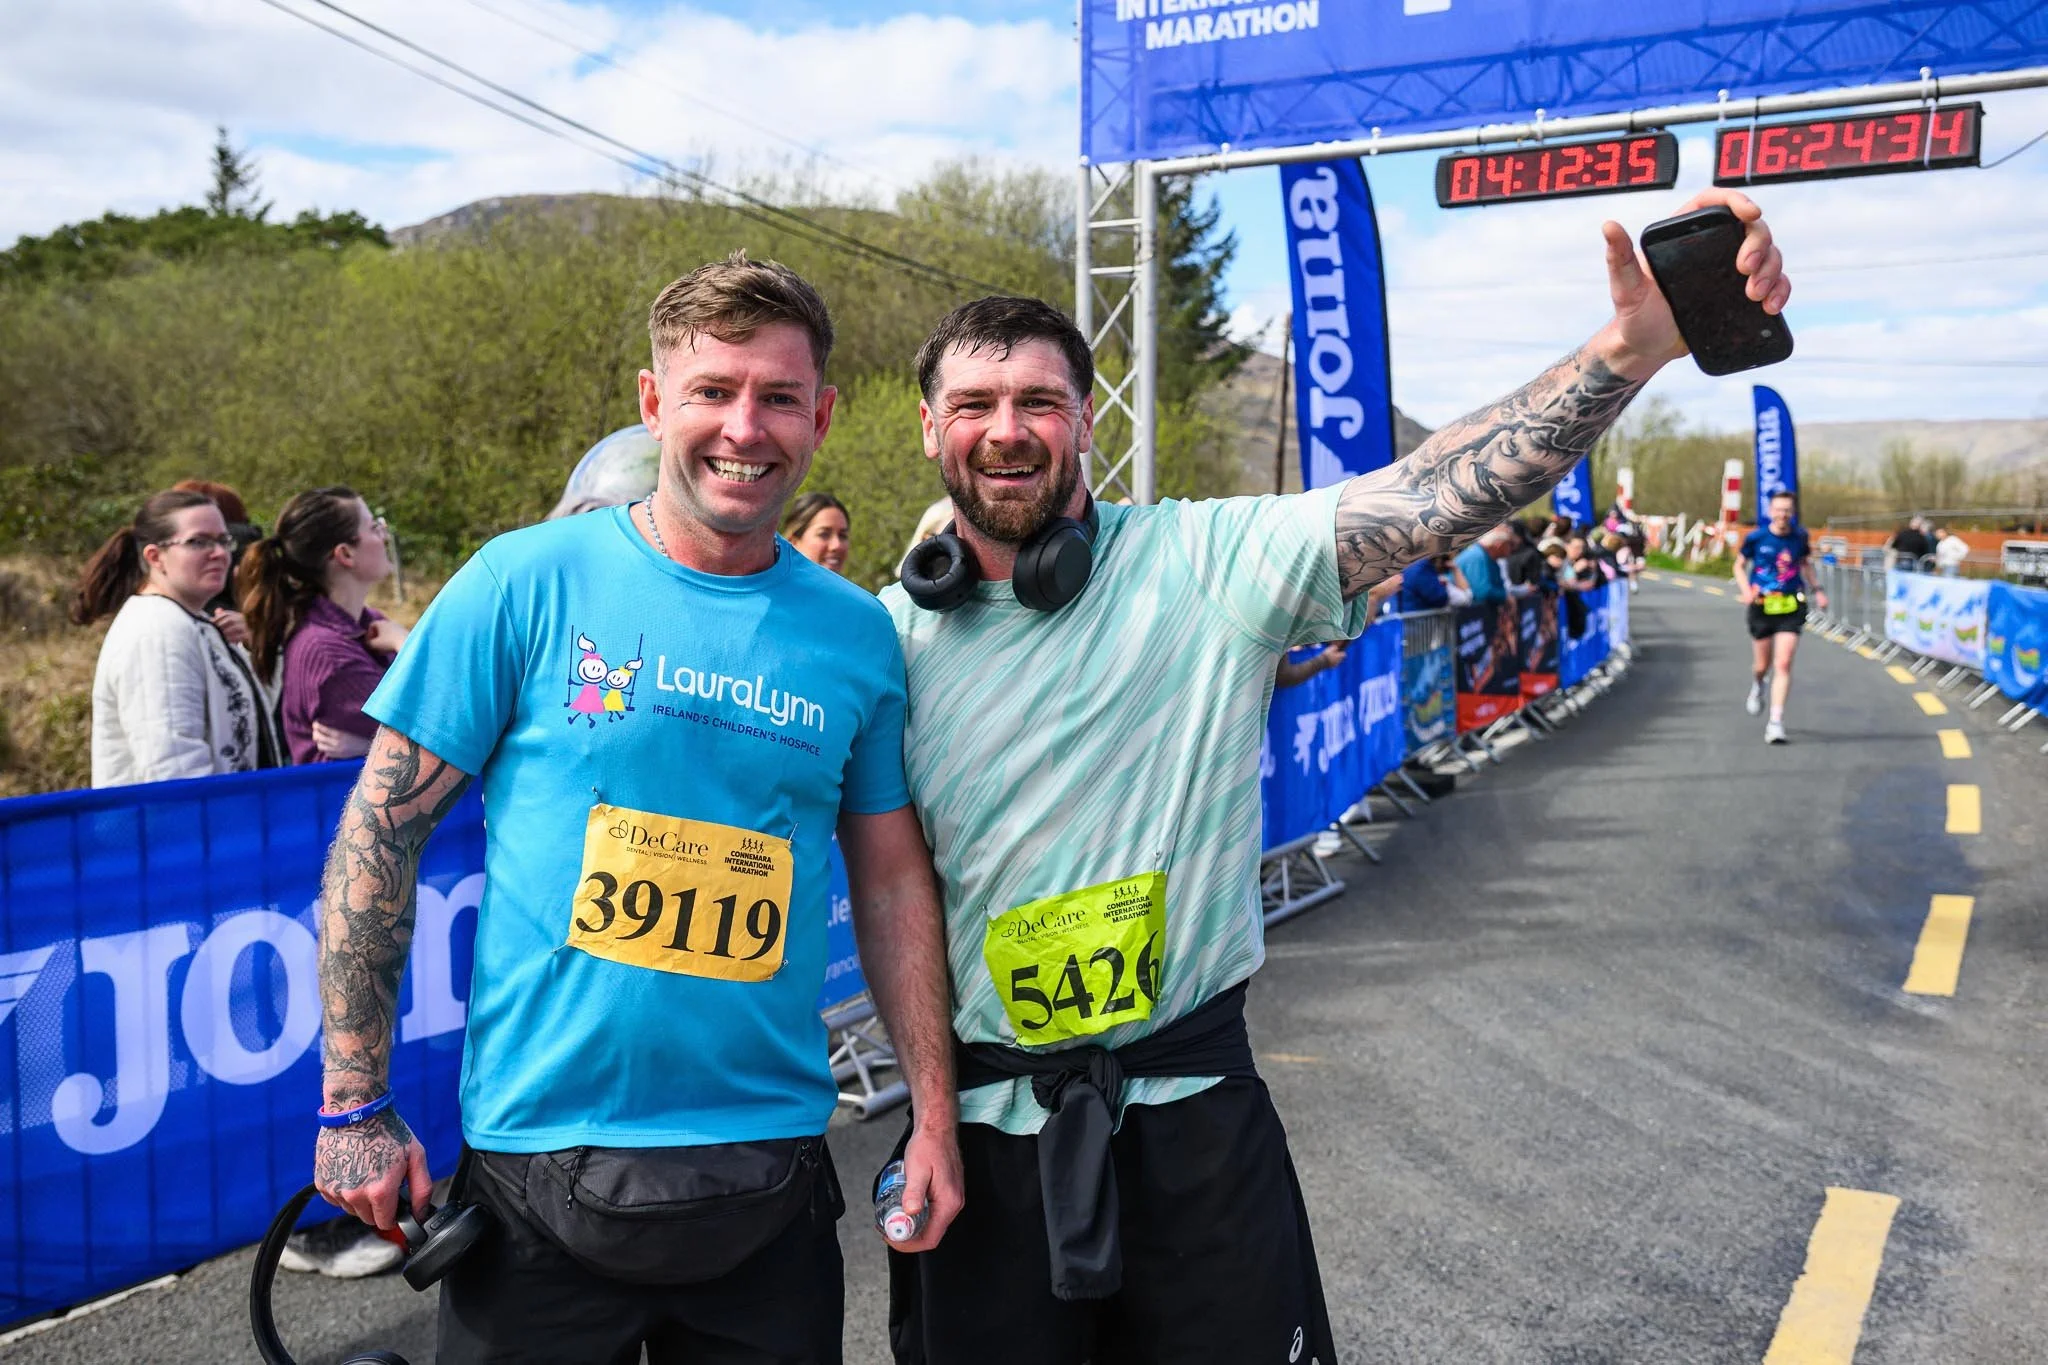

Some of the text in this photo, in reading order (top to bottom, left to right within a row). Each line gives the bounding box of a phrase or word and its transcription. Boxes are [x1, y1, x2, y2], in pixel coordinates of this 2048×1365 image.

[1146, 1, 1319, 49] MARATHON
[1718, 111, 1966, 177] 06:24:34
[1451, 139, 1657, 201] 04:12:35
[1290, 167, 1364, 439] Joma
[657, 655, 825, 732] LauraLynn
[653, 704, 820, 756] IRELAND'S CHILDREN'S HOSPICE
[626, 846, 708, 866] DENTAL VISION WELLNESS
[630, 826, 708, 857] DeCare
[730, 850, 771, 863] CONNEMARA
[724, 857, 775, 872] INTERNATIONAL
[730, 865, 769, 877] MARATHON
[575, 871, 782, 961] 39119
[1106, 895, 1150, 910] CONNEMARA
[1112, 908, 1150, 923] MARATHON
[1018, 909, 1086, 937] DeCare
[1011, 930, 1160, 1030] 5426
